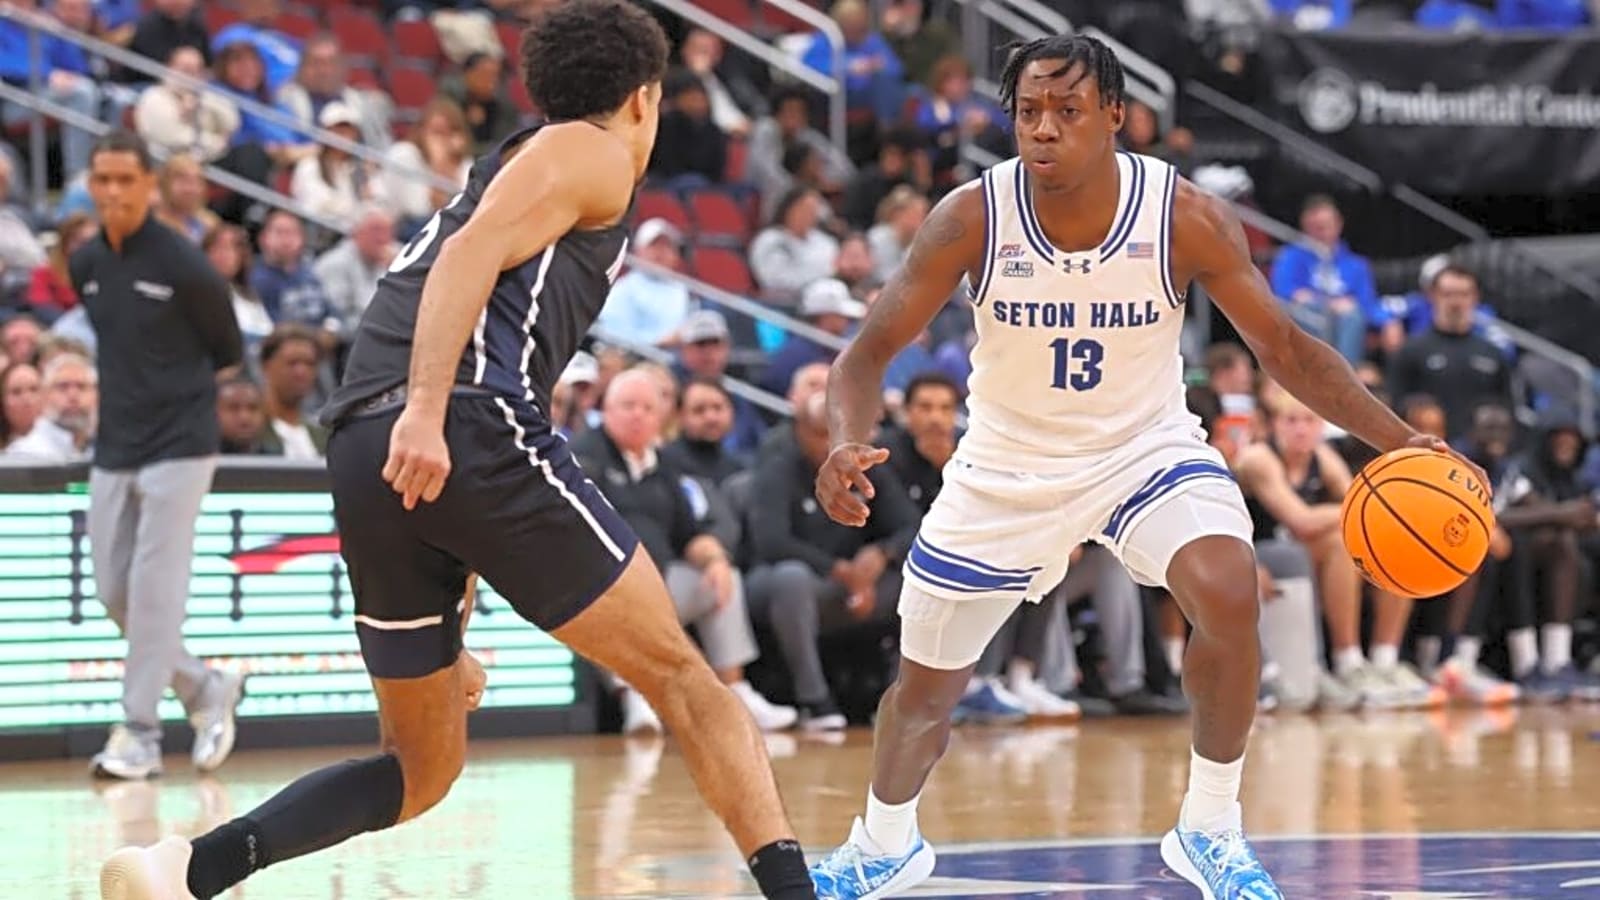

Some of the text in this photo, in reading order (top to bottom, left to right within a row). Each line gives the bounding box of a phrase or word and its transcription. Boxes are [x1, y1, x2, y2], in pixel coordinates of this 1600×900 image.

[1359, 82, 1523, 125] Prudential
[993, 299, 1160, 328] SETON HALL
[1048, 337, 1104, 391] 13
